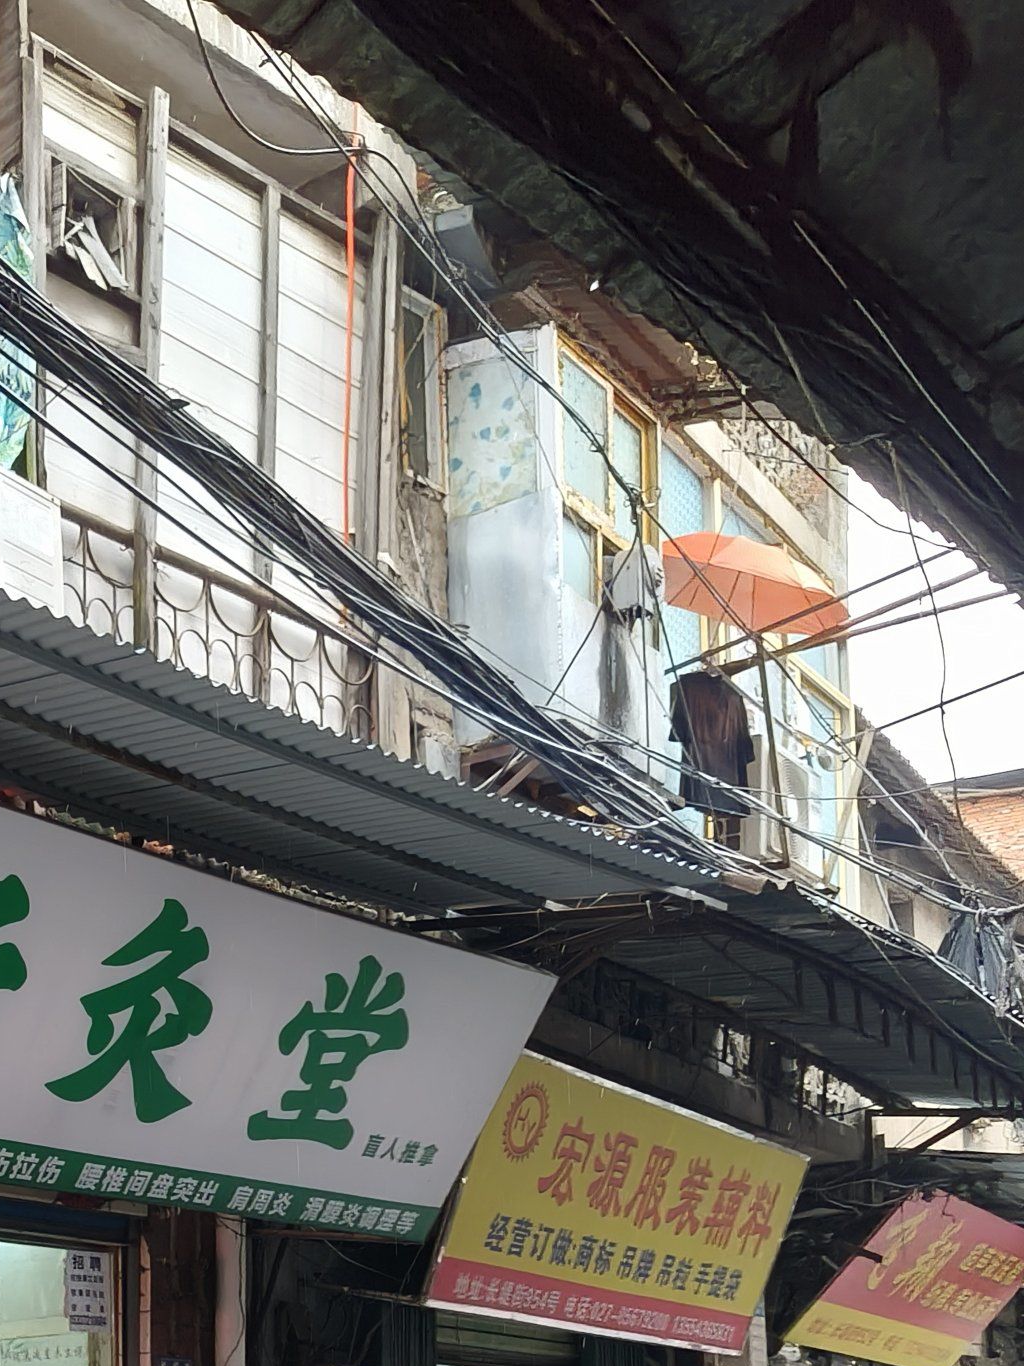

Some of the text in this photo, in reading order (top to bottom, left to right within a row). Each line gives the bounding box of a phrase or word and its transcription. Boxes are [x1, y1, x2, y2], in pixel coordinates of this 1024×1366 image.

[360, 1133, 439, 1167] 盲人推拿
[537, 1115, 782, 1258] 宏源服装辅料
[74, 1162, 220, 1207] 腰椎间盘突出
[226, 1185, 294, 1217] 肩周炎
[298, 1196, 420, 1235] 滑膜炎调理等
